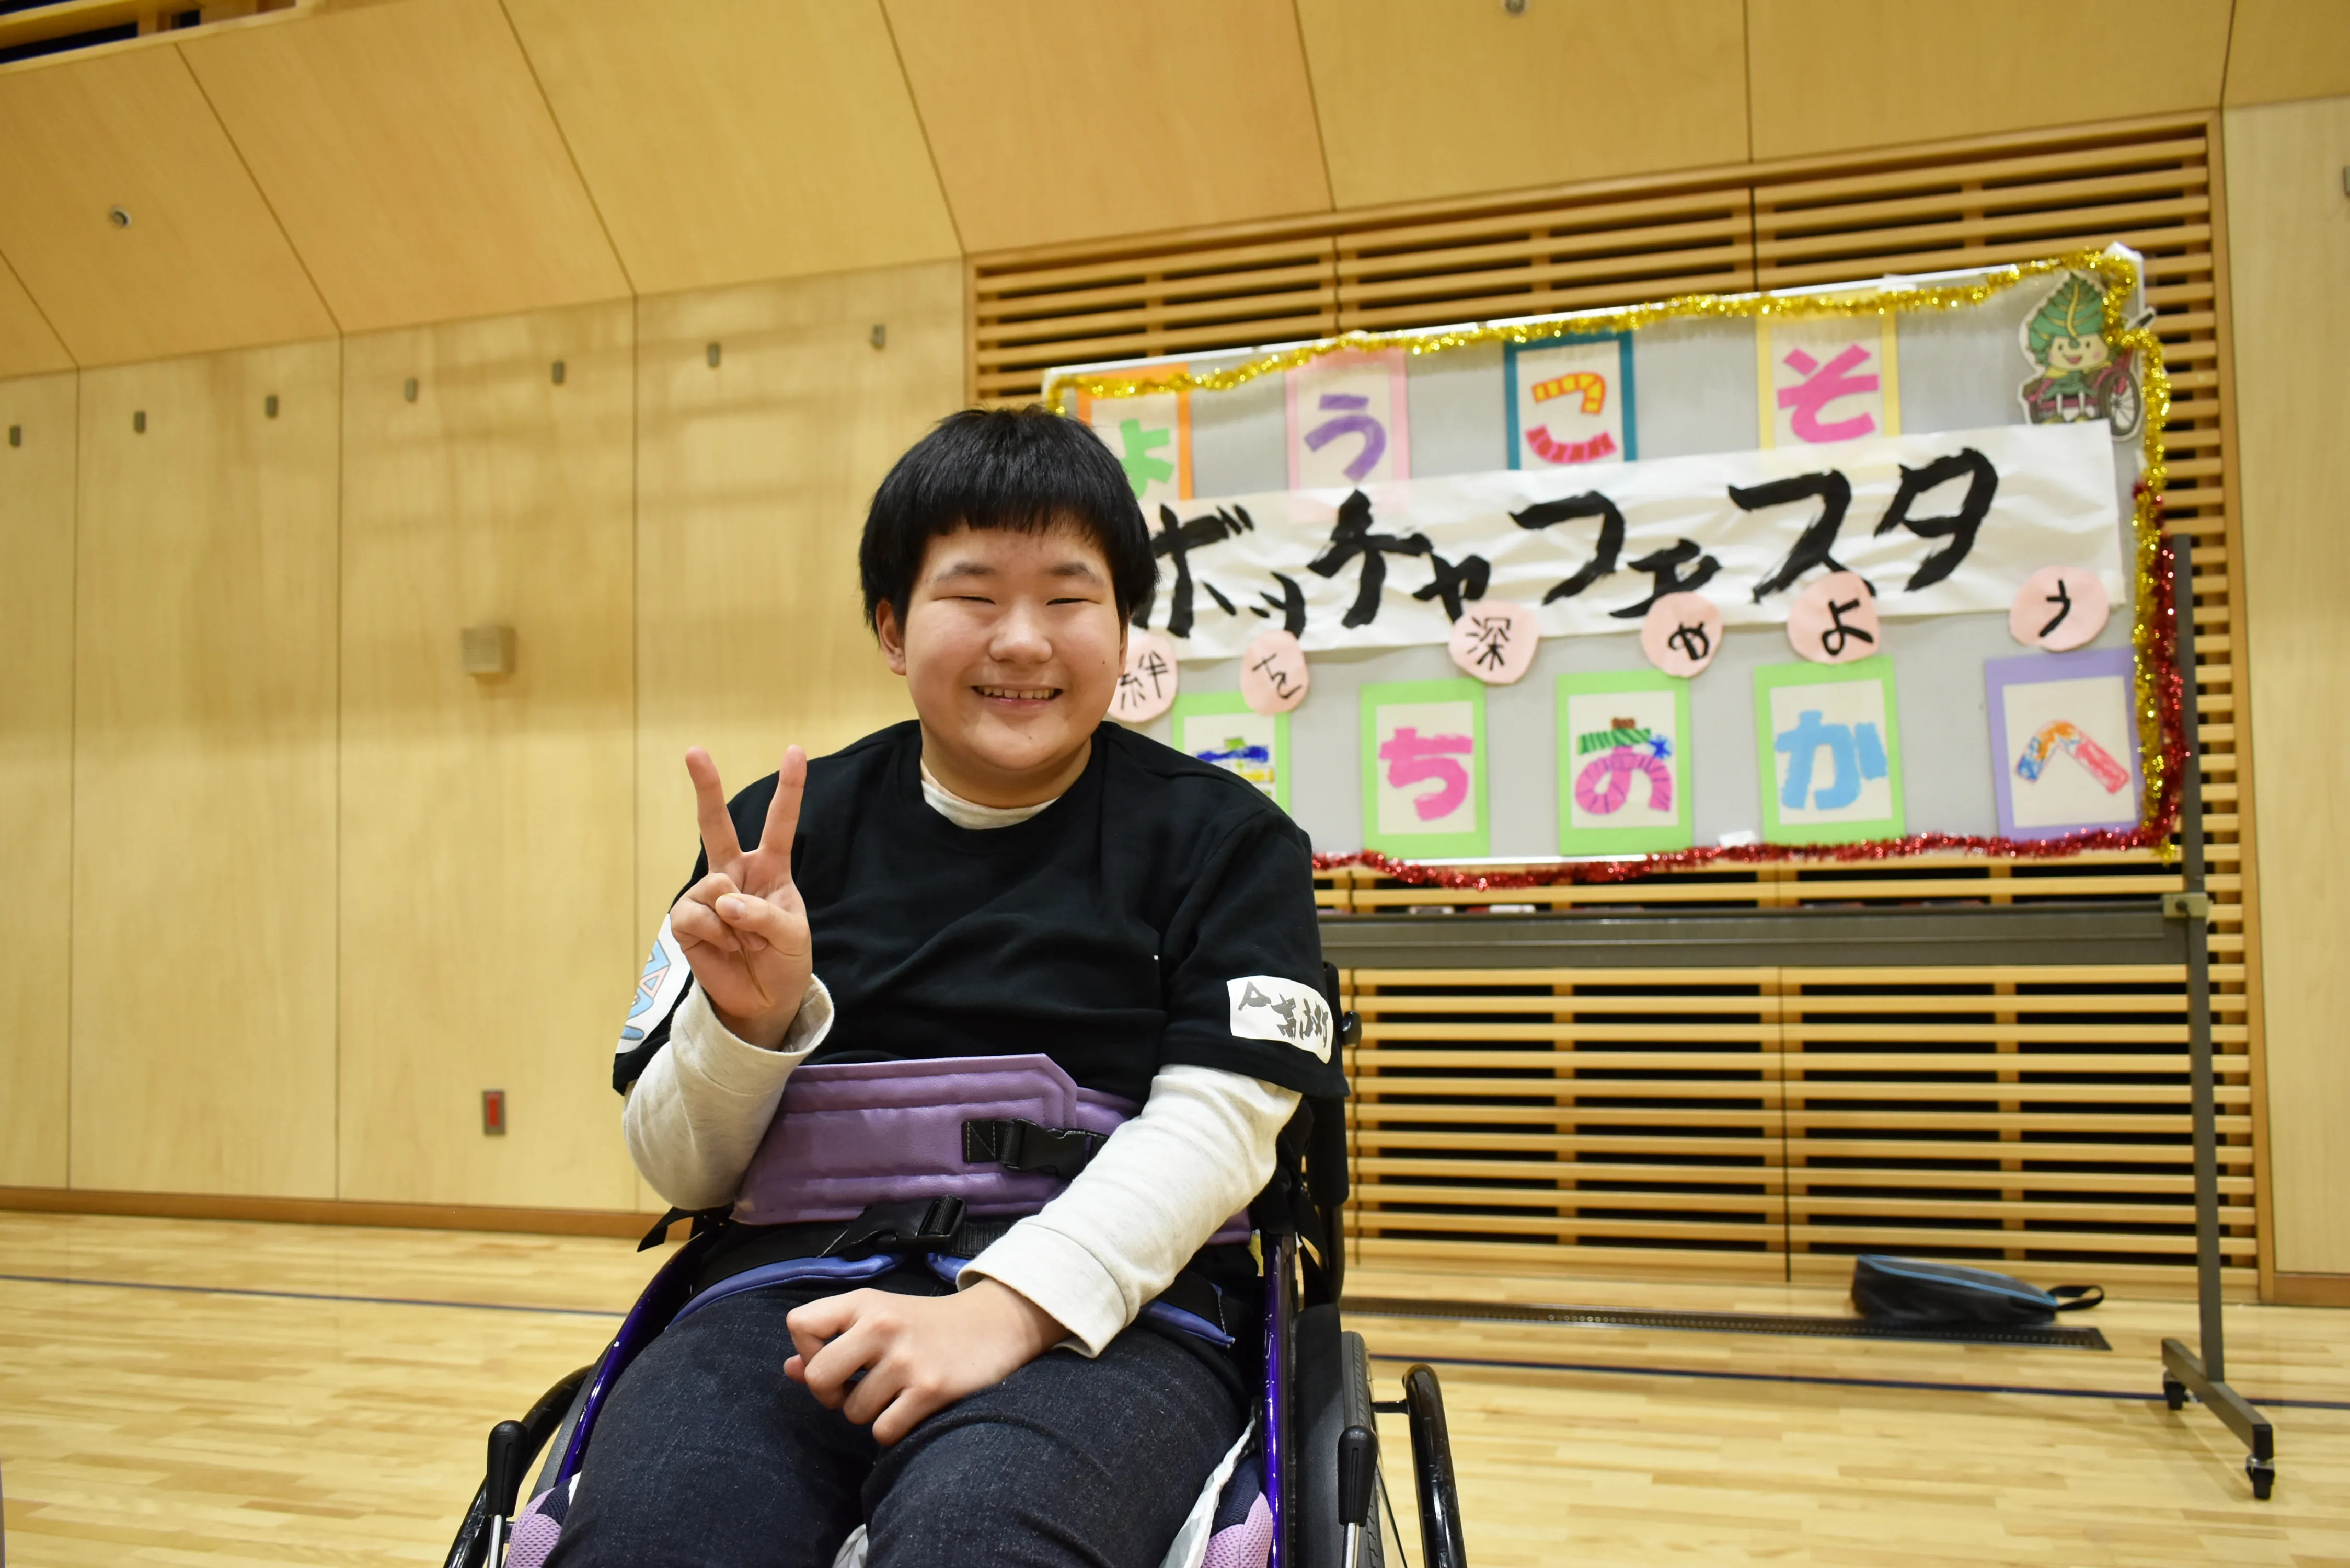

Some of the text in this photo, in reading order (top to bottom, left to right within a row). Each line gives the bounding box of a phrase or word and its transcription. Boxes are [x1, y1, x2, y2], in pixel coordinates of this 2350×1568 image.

[1120, 344, 1879, 500] ようこそ
[1131, 447, 1998, 639] ボッチャフェスタ
[1120, 578, 2071, 710] 絆を深めよう
